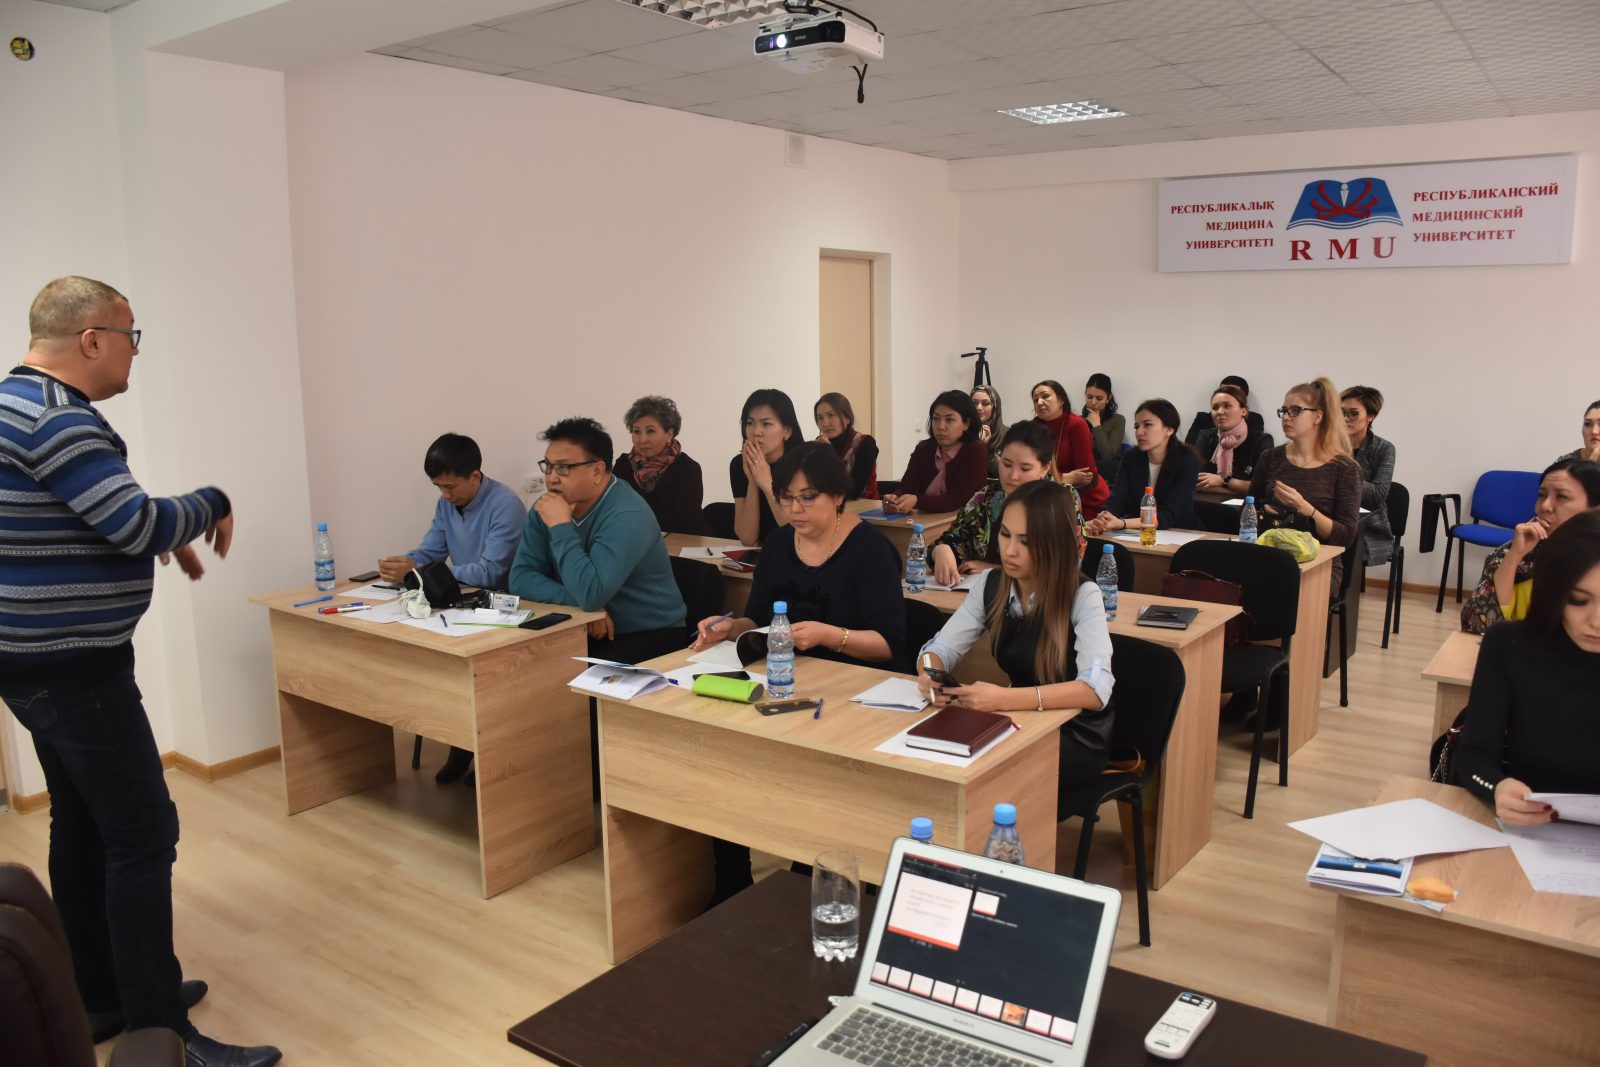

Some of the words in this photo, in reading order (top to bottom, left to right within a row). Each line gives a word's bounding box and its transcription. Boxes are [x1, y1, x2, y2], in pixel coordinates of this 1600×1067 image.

[1413, 182, 1559, 202] РЕСПУБЛИКАНСКИЙ
[1170, 200, 1275, 214] РЕСПУБЛИКАЛЫҚ
[1412, 205, 1524, 223] МЕДИЦИНСКИЙ
[1205, 219, 1274, 232] МЕДИЦИНА
[1413, 229, 1516, 243] УНИВЕРСИТЕТ
[1185, 238, 1274, 250] УНИВЕРСИТЕТІ
